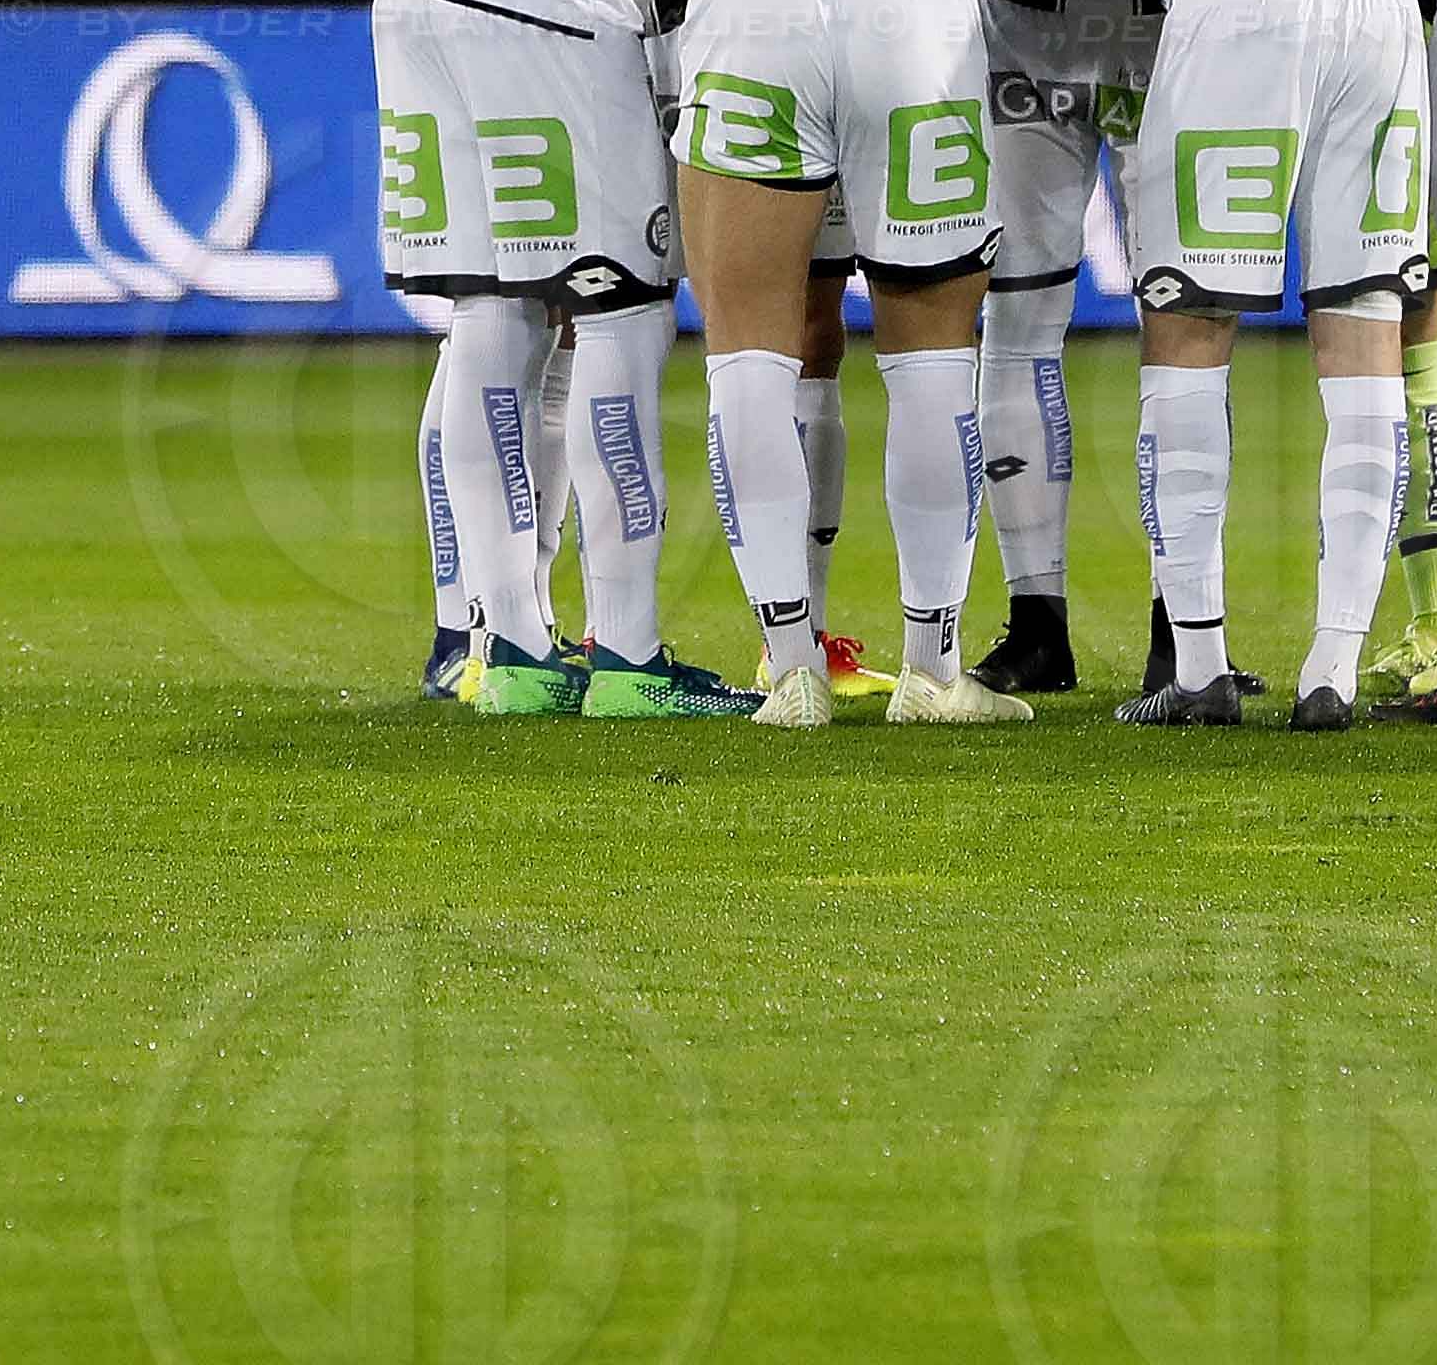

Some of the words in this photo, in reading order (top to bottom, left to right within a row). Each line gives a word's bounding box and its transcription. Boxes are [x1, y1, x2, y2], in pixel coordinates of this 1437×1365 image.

[1182, 251, 1226, 265] ENERGIE
[488, 391, 534, 527] PUNTIGAMER
[594, 400, 656, 537] PUNTIGAMER
[1037, 364, 1073, 477] PUNTIGAMER
